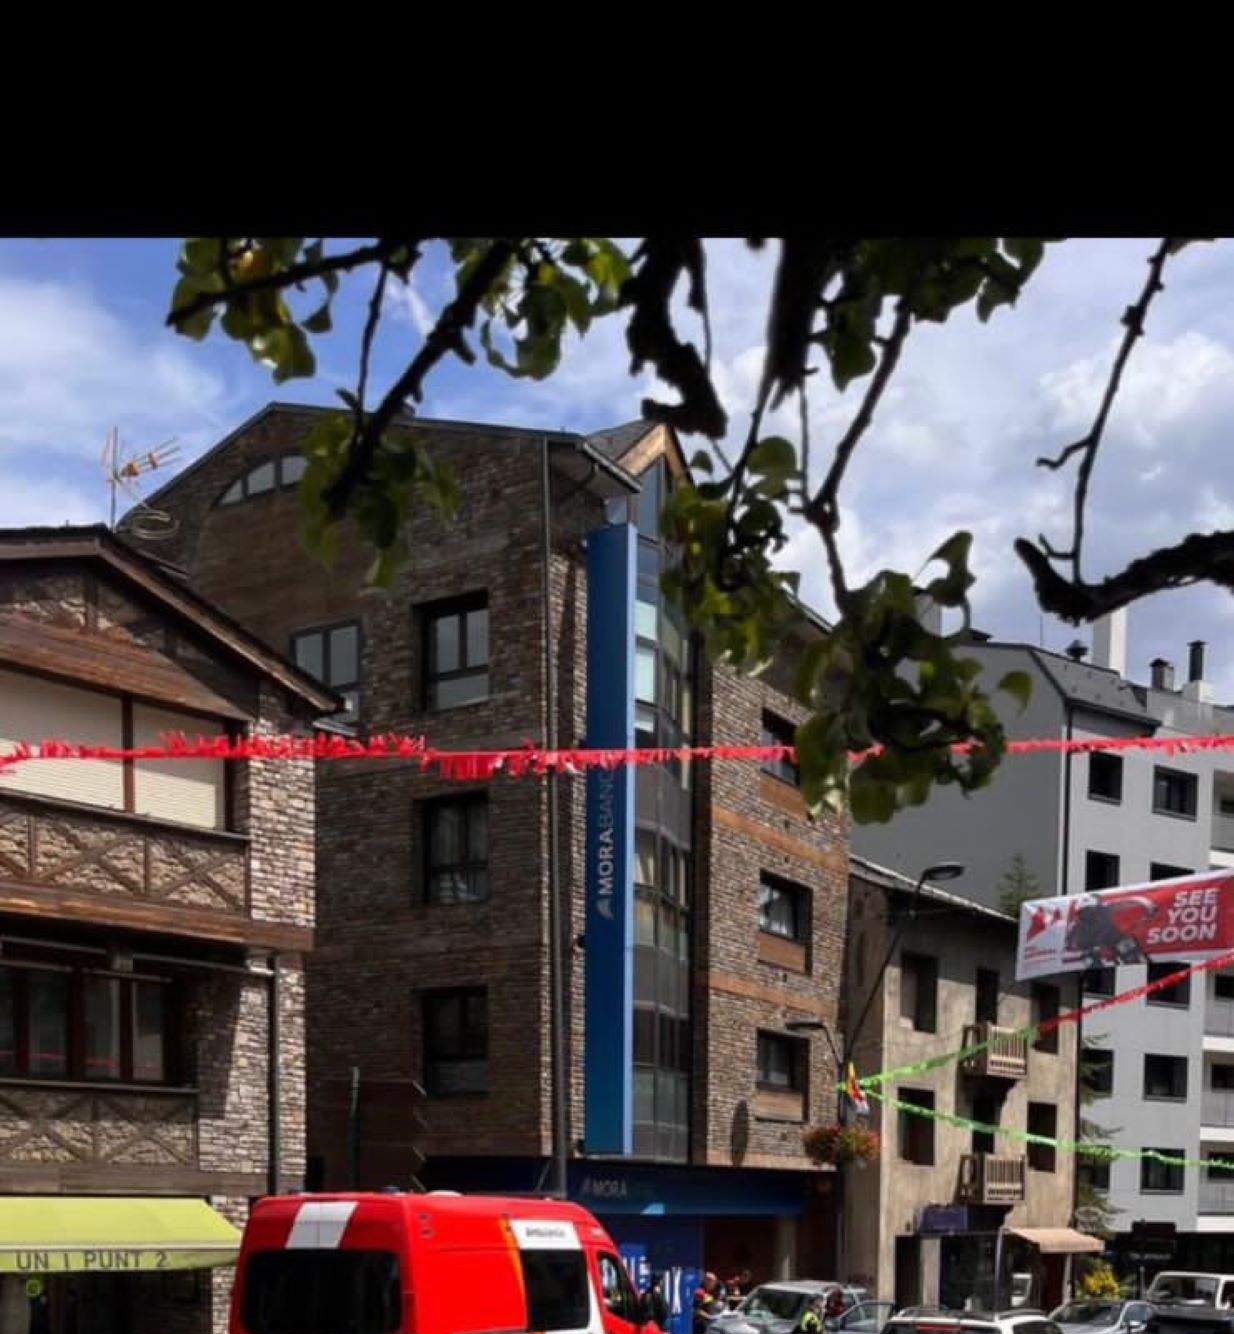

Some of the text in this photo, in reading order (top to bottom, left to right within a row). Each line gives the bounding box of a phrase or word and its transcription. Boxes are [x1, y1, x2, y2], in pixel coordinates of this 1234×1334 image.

[1173, 888, 1219, 907] SEE
[1167, 906, 1217, 924] YOU
[1146, 923, 1217, 944] SOON
[16, 1252, 49, 1269] UN
[84, 1250, 141, 1268] PUNT
[156, 1251, 168, 1267] 2
